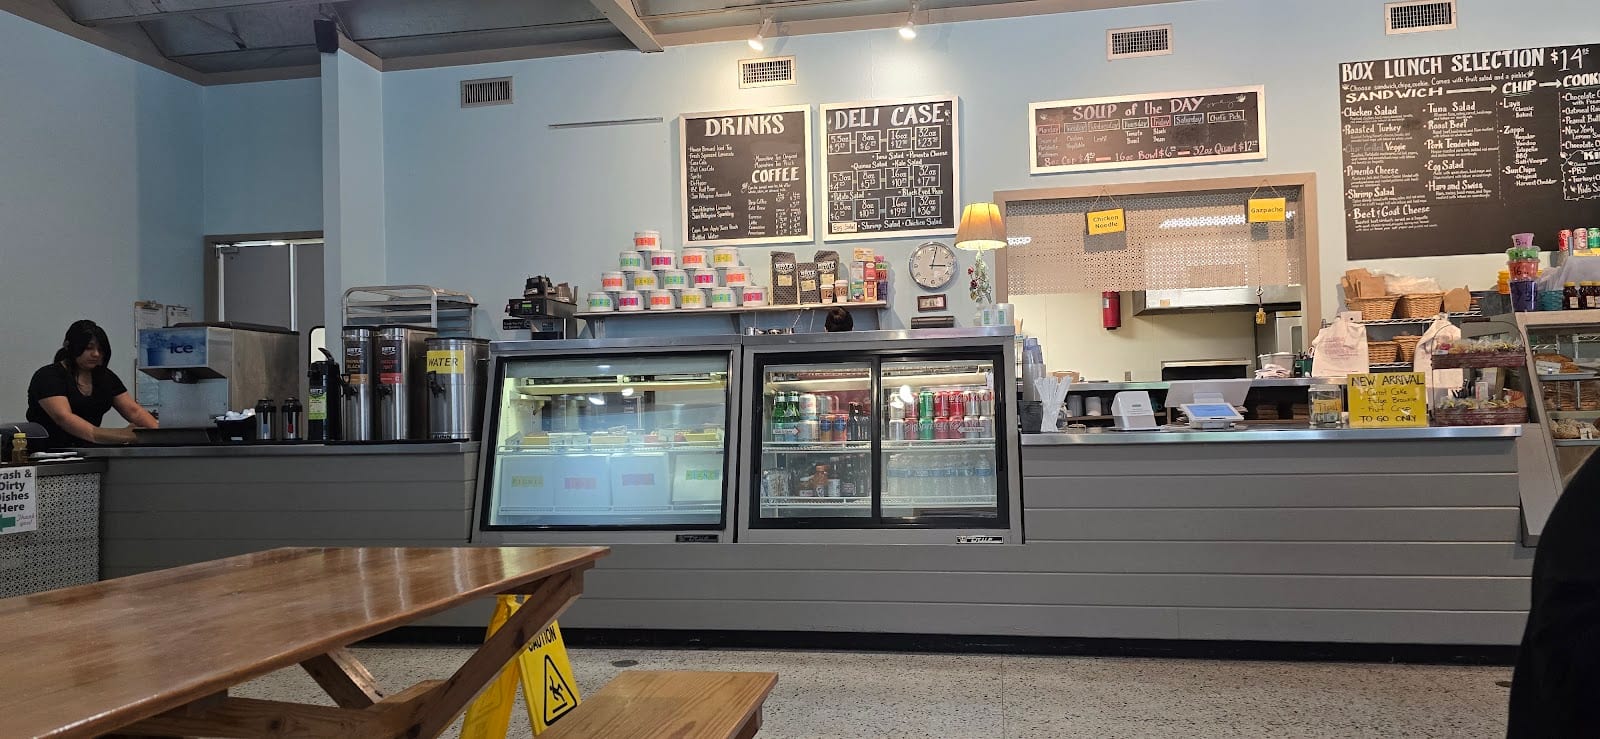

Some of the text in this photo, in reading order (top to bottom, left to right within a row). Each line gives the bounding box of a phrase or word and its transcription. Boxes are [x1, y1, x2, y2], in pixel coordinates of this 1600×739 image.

[1342, 48, 1544, 82] BOX LUNCH SELECTION
[1432, 77, 1450, 85] Comes
[1502, 80, 1537, 94] CHIP
[1346, 87, 1443, 103] SANDWICH
[1565, 92, 1595, 101] Chocolate
[1072, 104, 1117, 120] SOUP
[1125, 103, 1138, 116] of
[1144, 102, 1162, 115] the
[1170, 97, 1205, 113] DAY
[1344, 104, 1398, 117] Chicken Salad
[1427, 101, 1476, 113] Tuna Salad
[1565, 106, 1589, 114] Oatmeal
[835, 103, 945, 130] DELI CASE
[1153, 117, 1170, 126] Friday
[1175, 116, 1202, 125] Saturday
[1565, 116, 1586, 124] Peanut
[704, 114, 784, 136] DRINKS
[1344, 123, 1401, 135] Roasted Turkey
[1428, 118, 1467, 130] Roast Beef
[1565, 124, 1594, 134] New York
[862, 128, 936, 141] 8oz 16oz 32oz
[1385, 141, 1406, 152] Veggie
[1427, 138, 1480, 149] Pork Tenderloin
[1565, 140, 1594, 149] Chocolate
[889, 152, 904, 160] Salad
[1138, 150, 1158, 159] Bowl
[1192, 145, 1212, 155] 32oz
[1214, 142, 1237, 154] Quart
[872, 161, 888, 169] Salad
[907, 158, 923, 167] Salad
[1427, 159, 1464, 171] Egg Salad
[751, 168, 800, 183] COFFEE
[891, 168, 907, 178] 16oz
[918, 166, 936, 176] 32oz
[1346, 165, 1398, 176] Pimento Cheese
[918, 187, 931, 195] Eyed
[1428, 180, 1446, 191] Ham
[1447, 180, 1460, 190] and
[1462, 180, 1483, 189] Swiss
[849, 191, 864, 199] Salad
[1348, 186, 1395, 199] Shrimp Salad
[862, 196, 936, 209] 8oz 16oz 32oz
[1251, 206, 1283, 214] Gazpacho
[1352, 204, 1430, 219] Beet Goat Cheese
[170, 342, 193, 354] ice
[428, 358, 458, 367] WATER
[1351, 374, 1424, 386] NEW ARRIVAL
[1368, 397, 1387, 406] Fudge
[25, 469, 32, 478] &
[0, 492, 29, 501] ishes
[0, 504, 24, 512] Here
